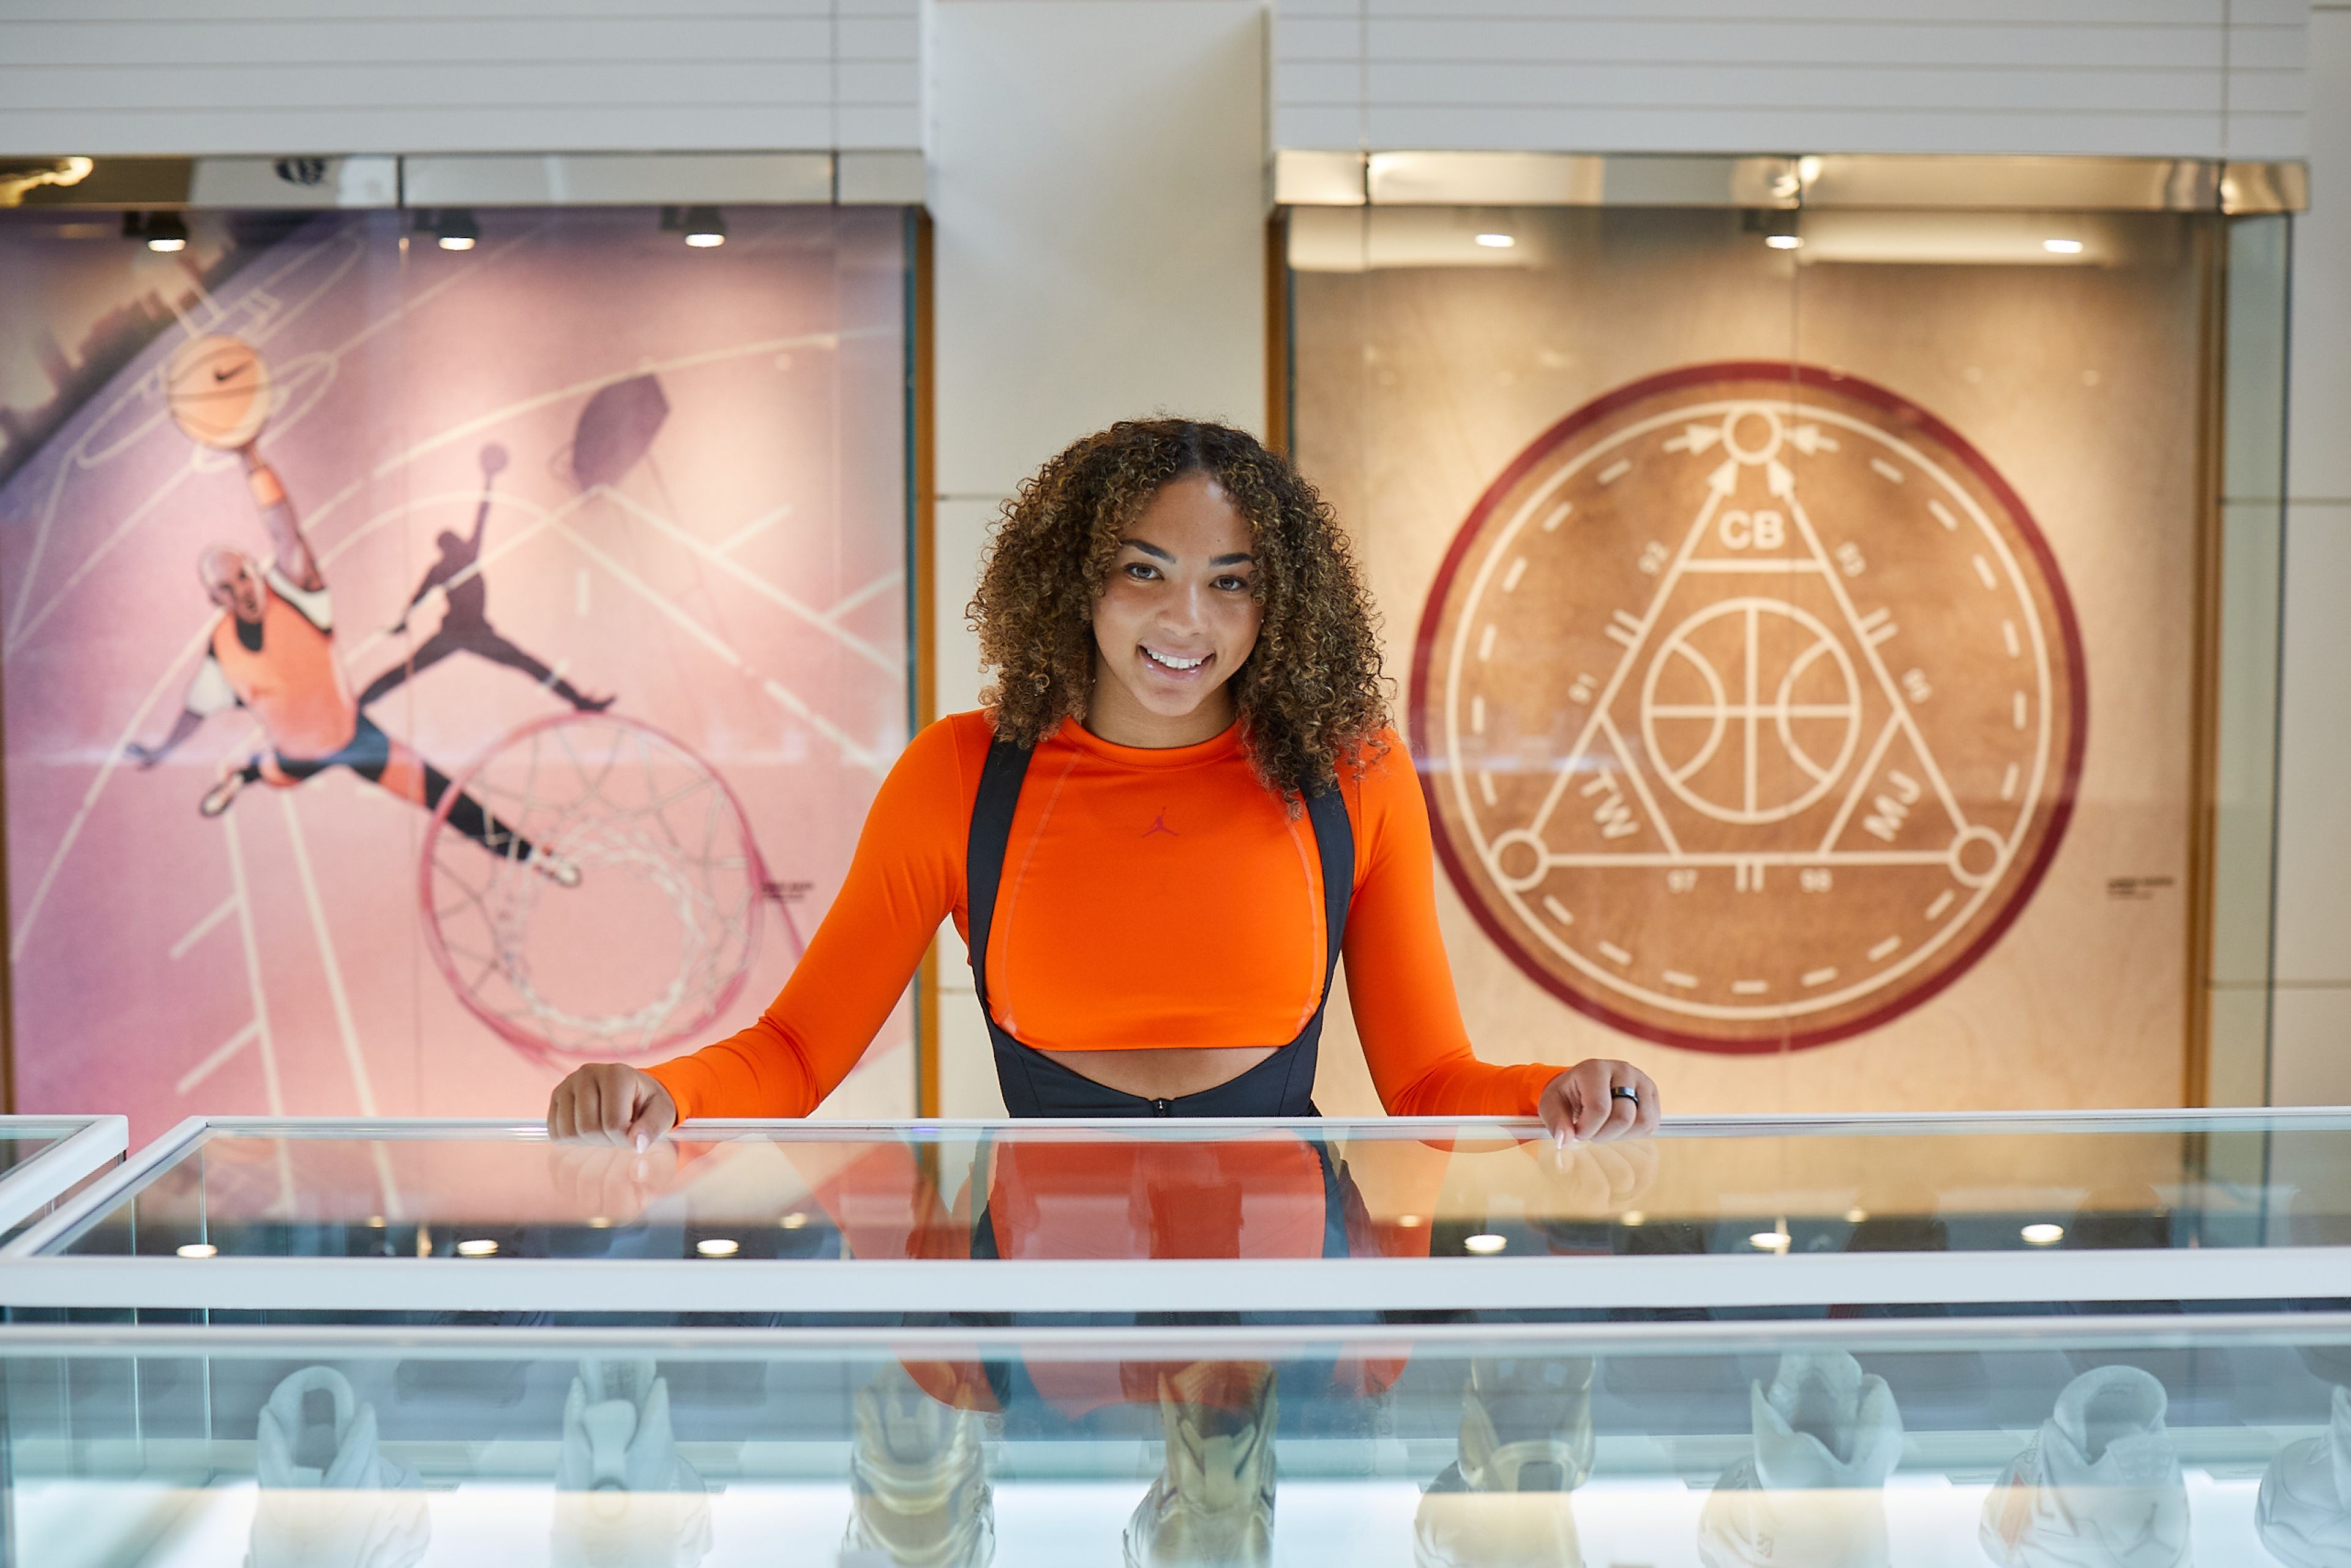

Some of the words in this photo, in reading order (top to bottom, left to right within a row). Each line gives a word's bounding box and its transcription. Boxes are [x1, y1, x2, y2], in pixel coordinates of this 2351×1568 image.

[1719, 509, 1785, 550] CB
[1580, 764, 1640, 838] TW
[1862, 770, 1920, 842] MJ
